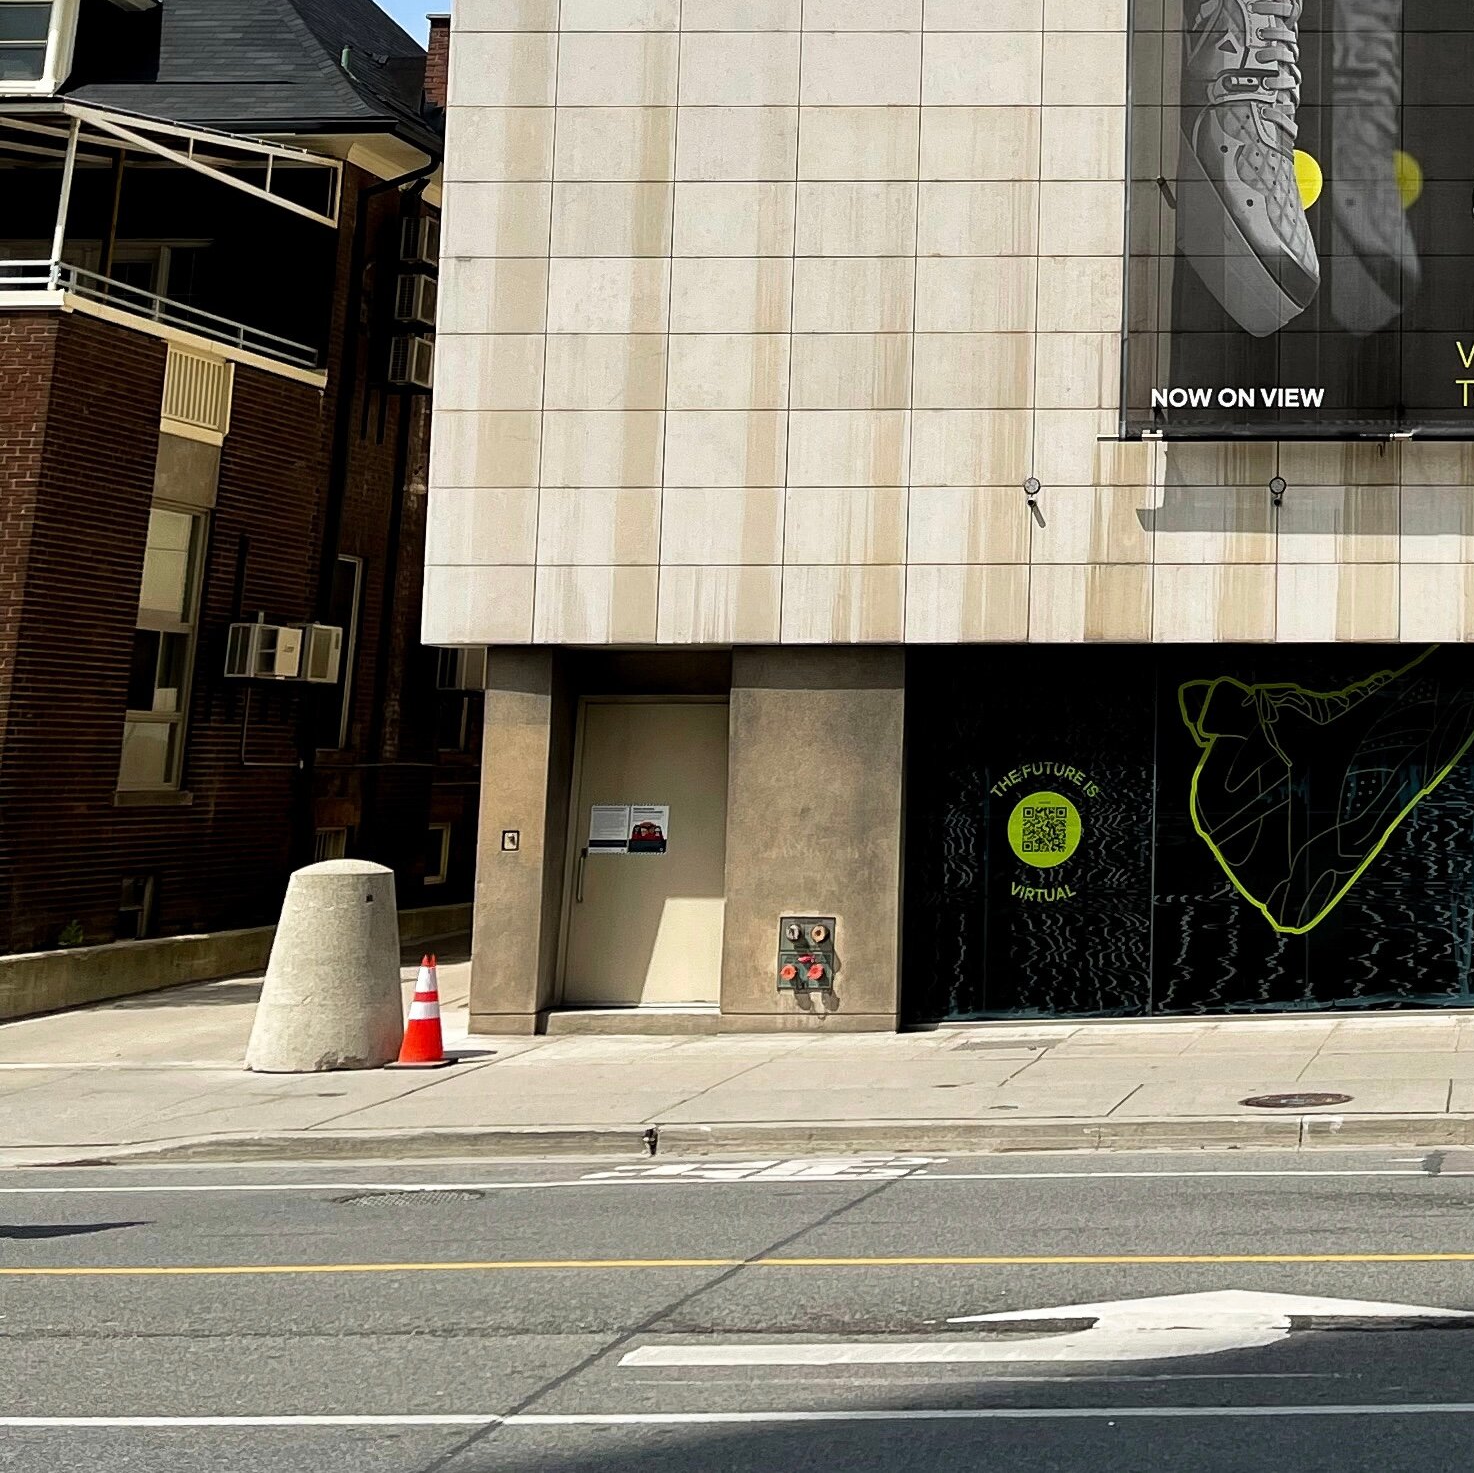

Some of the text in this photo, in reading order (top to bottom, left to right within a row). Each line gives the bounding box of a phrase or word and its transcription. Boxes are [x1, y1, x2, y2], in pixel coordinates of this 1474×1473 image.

[1151, 387, 1325, 408] NOW ON VIEW
[990, 761, 1100, 797] THE FUTURE IS
[1011, 881, 1077, 903] VIRTUAL
